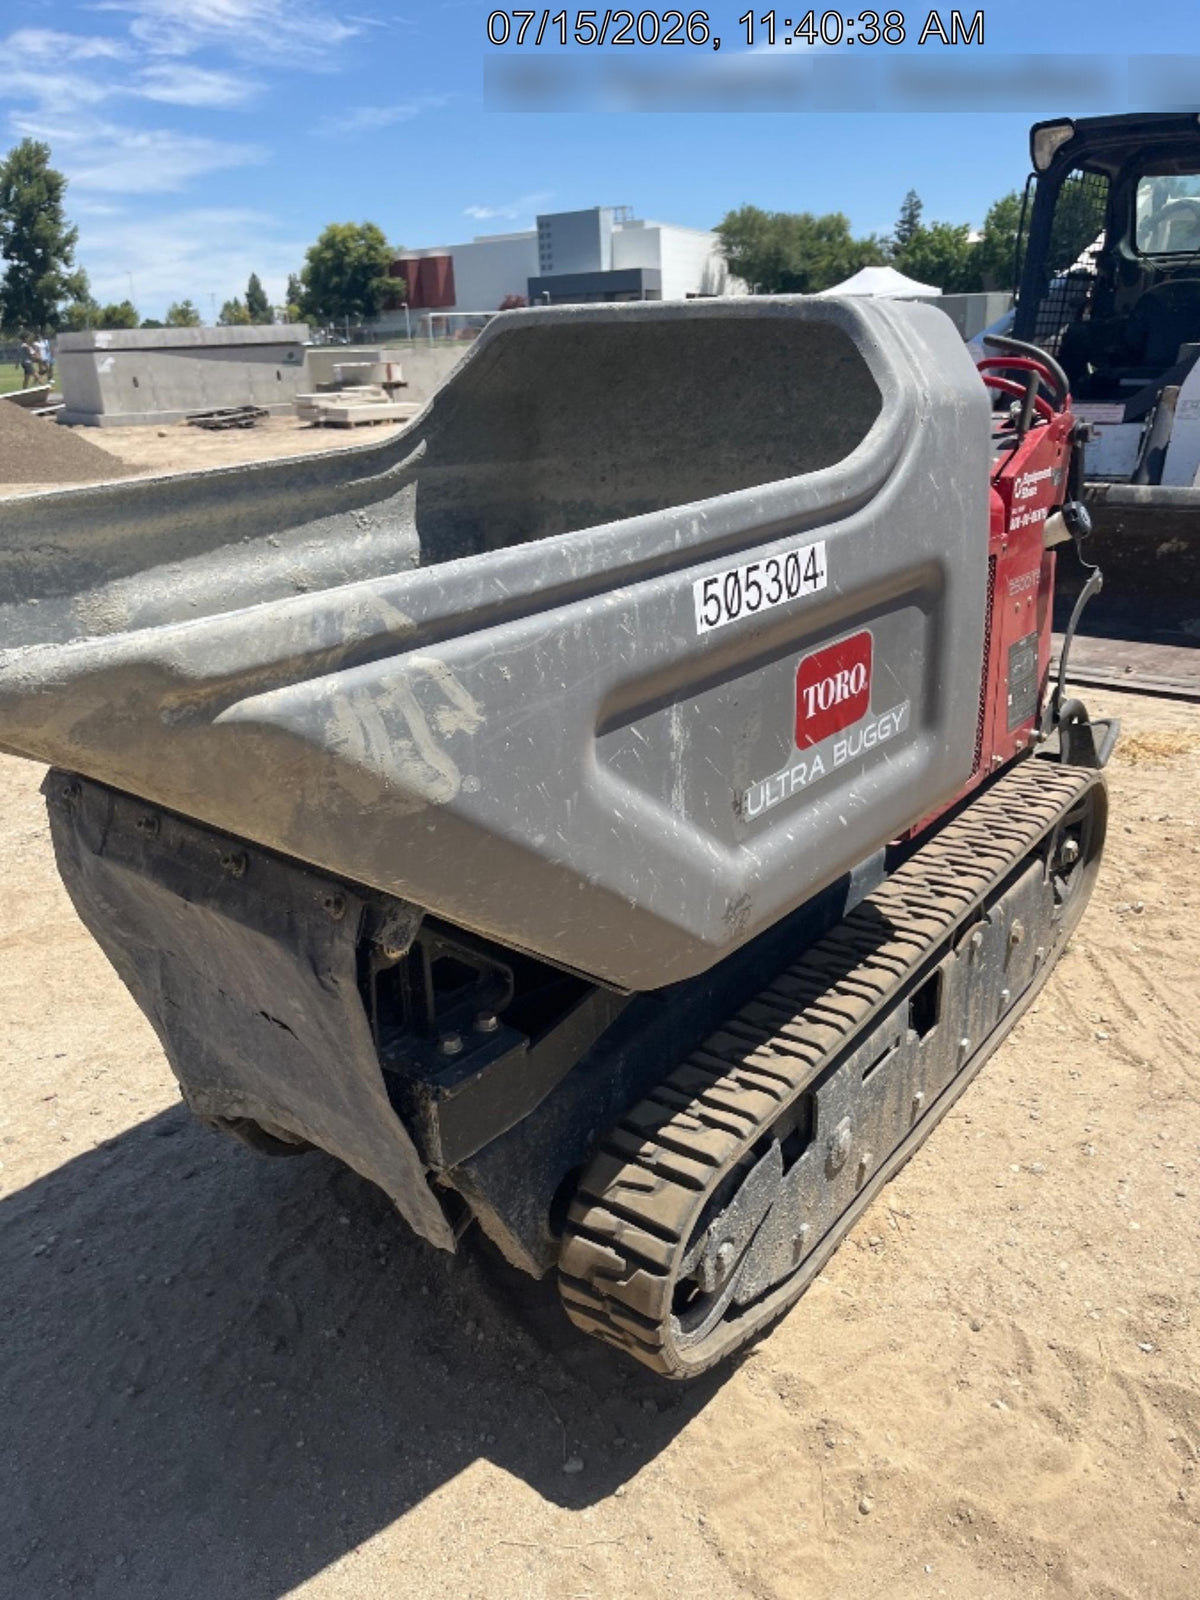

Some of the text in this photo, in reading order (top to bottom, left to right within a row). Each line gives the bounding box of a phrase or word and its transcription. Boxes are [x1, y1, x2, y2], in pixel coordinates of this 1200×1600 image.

[702, 546, 818, 627] 505304
[803, 662, 867, 720] TORO
[748, 707, 905, 816] ULTRA BUGGY
